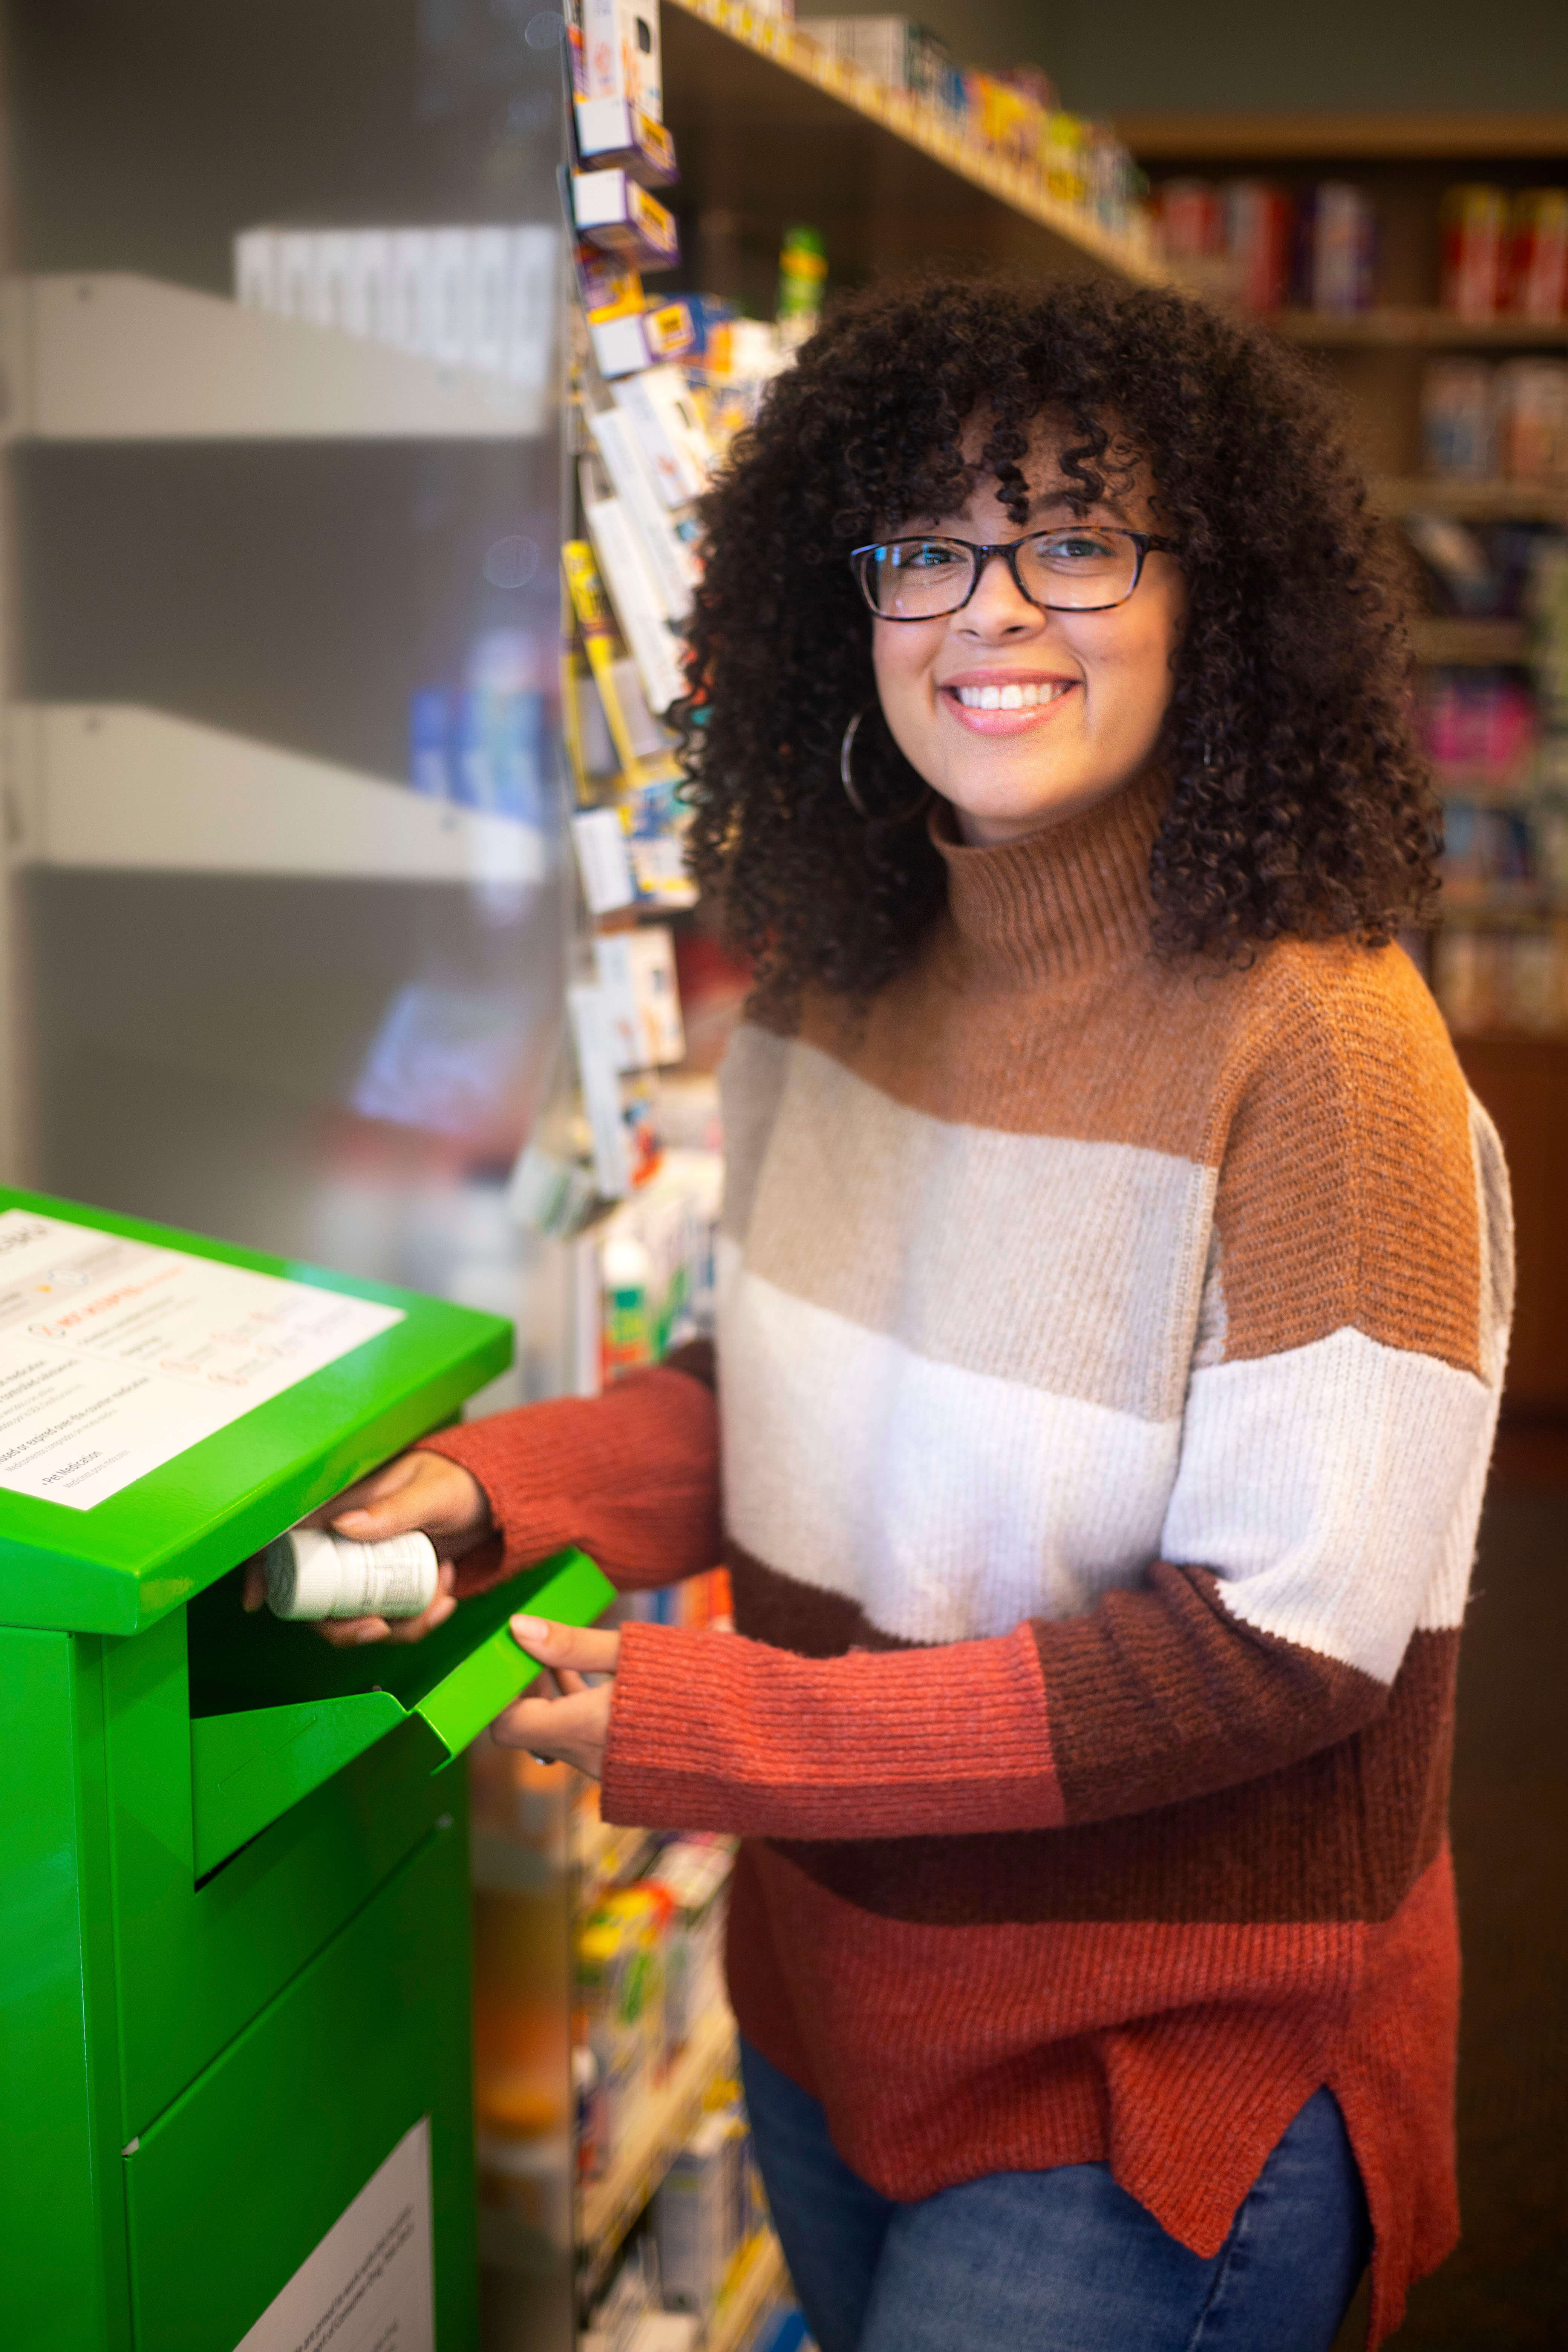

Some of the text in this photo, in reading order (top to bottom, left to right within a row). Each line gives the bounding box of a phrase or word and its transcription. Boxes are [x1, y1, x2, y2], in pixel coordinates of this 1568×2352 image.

[26, 1427, 57, 1446] expired
[42, 1451, 103, 1484] Pet Medication
